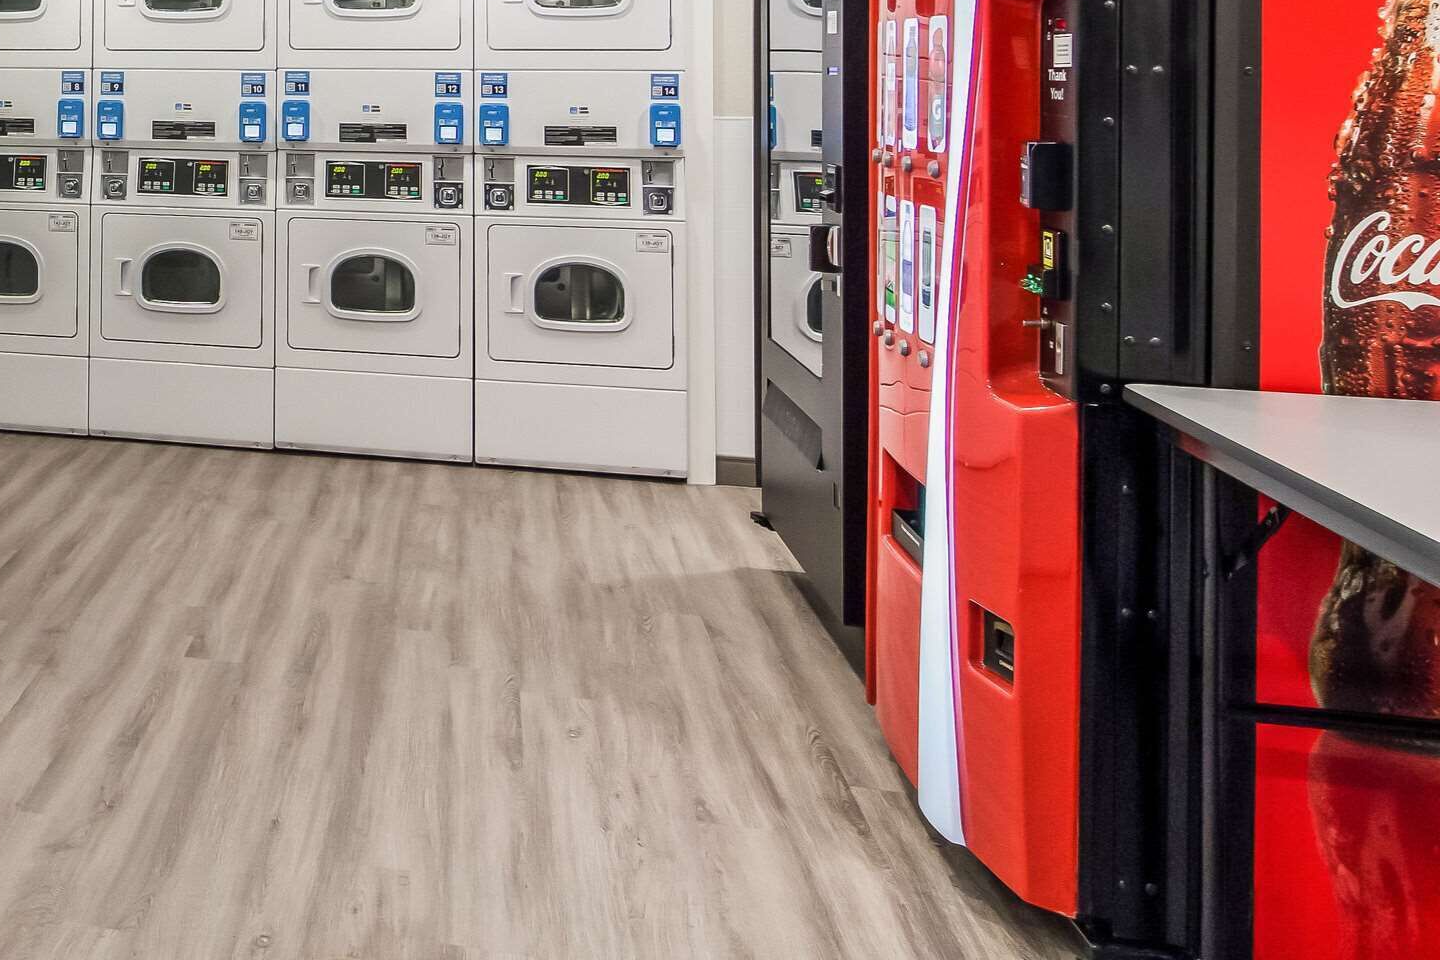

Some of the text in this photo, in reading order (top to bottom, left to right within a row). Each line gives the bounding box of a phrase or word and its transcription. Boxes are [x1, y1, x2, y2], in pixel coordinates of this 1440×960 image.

[1048, 68, 1067, 82] Thank
[74, 83, 80, 91] 8
[113, 83, 120, 91] 9
[252, 85, 263, 93] 10
[297, 83, 305, 91] 11
[447, 85, 458, 93] 12
[494, 85, 504, 93] 13
[664, 87, 675, 95] 14
[1050, 87, 1065, 100] You!
[931, 98, 942, 121] G
